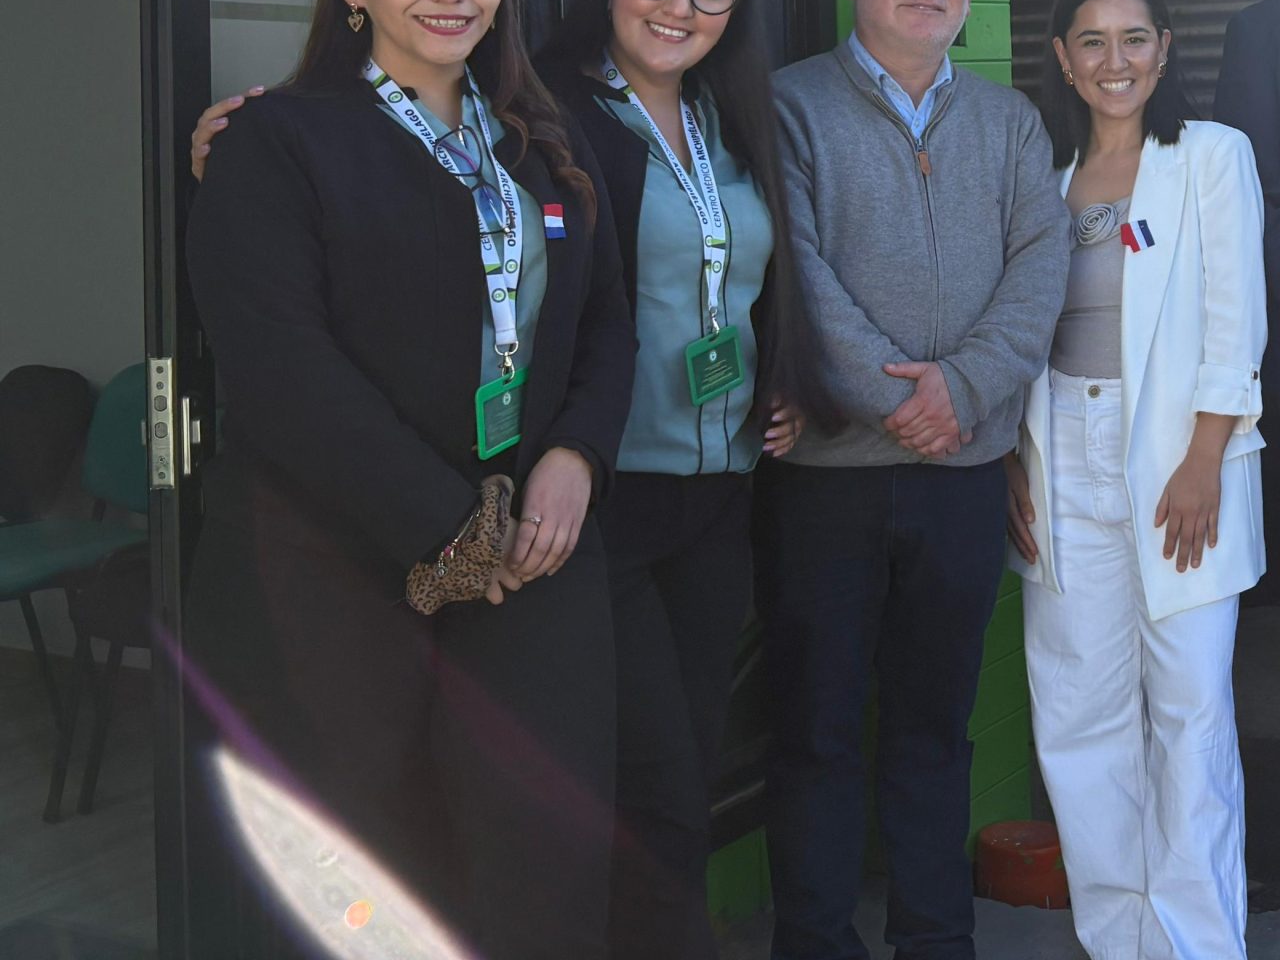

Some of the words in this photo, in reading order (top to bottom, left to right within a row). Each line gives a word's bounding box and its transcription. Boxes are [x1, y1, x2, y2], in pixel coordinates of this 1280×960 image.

[685, 110, 705, 161] ARCHIPIÉLAGO
[673, 161, 708, 225] ARCHIPIÉLAGO
[700, 162, 714, 194] MÉDICO
[709, 195, 721, 228] CENTRO
